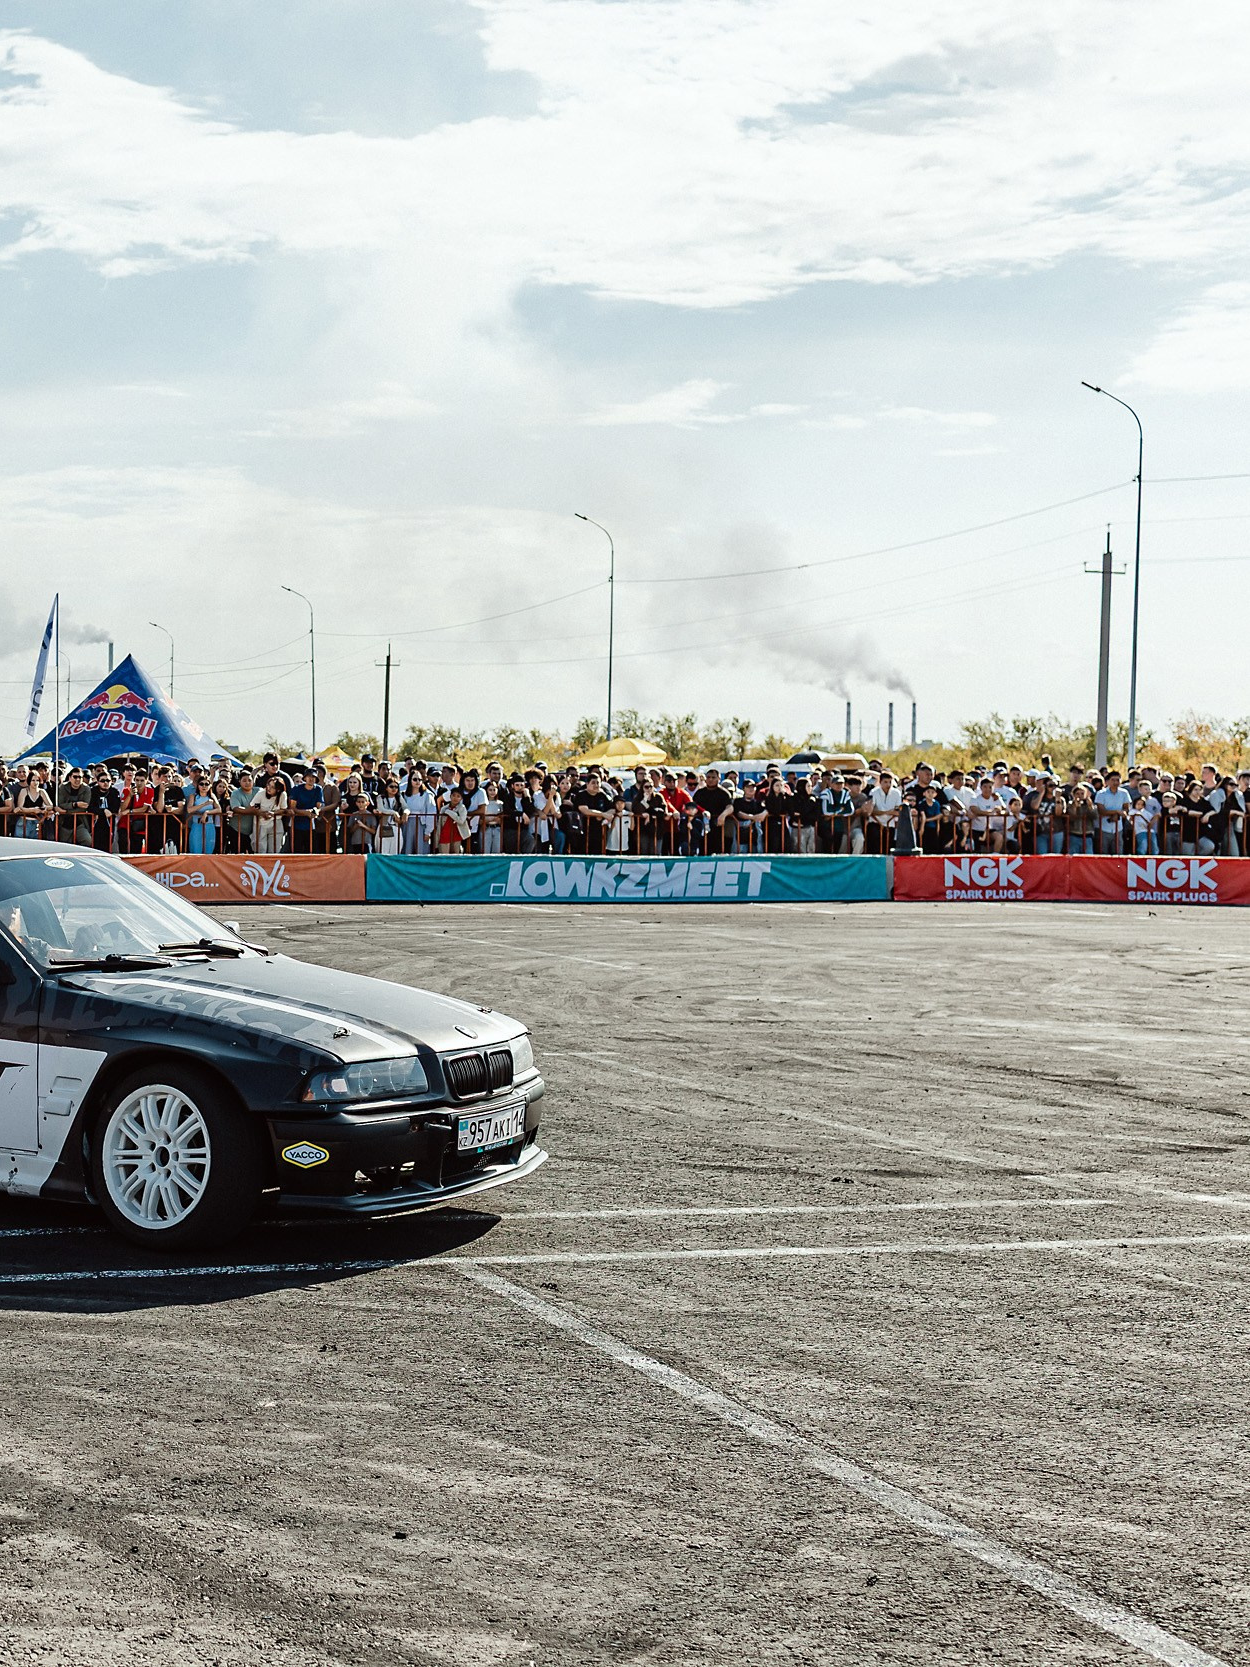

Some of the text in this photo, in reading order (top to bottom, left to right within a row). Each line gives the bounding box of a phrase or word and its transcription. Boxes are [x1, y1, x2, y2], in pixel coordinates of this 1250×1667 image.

[58, 711, 106, 739] Red
[102, 711, 158, 739] Bull
[505, 861, 771, 898] LOWKZMEET
[944, 858, 1024, 887] NGK
[1127, 859, 1218, 890] NGK
[945, 889, 1024, 899] SPARK PLUGS
[1127, 891, 1218, 902] SPARK PLUGS
[459, 1136, 468, 1147] KZ
[290, 1151, 322, 1159] YACCO
